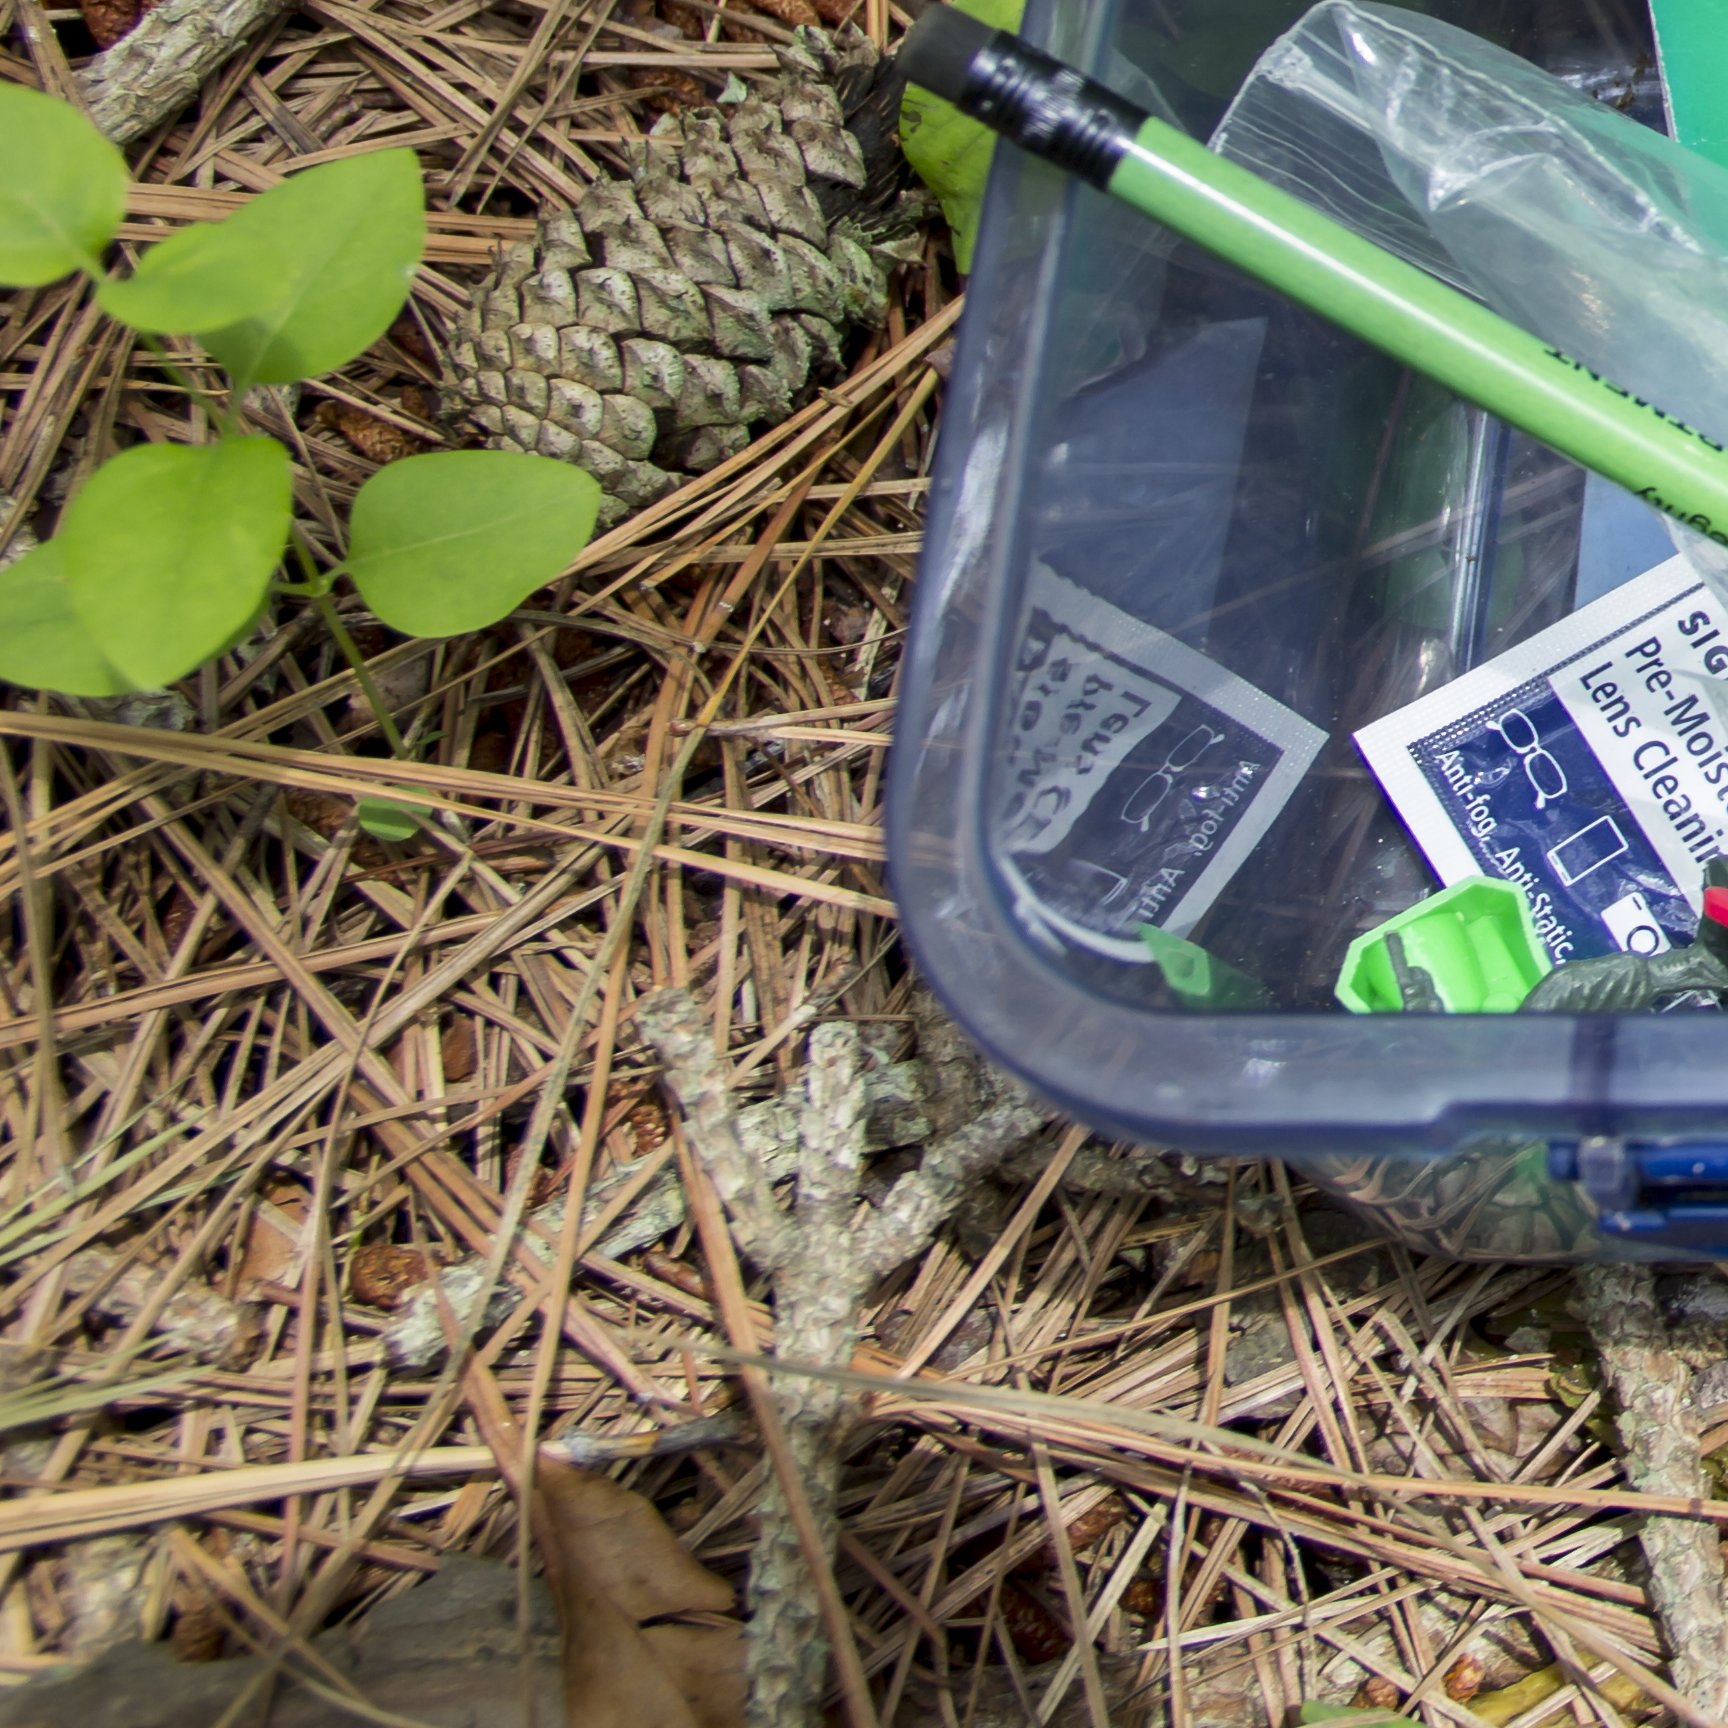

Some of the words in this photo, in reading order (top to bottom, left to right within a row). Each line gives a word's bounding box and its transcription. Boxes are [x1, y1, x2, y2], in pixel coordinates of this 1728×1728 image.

[1435, 749, 1496, 842] Anti-fog,
[1496, 846, 1575, 964] Anti-Static,
[1579, 661, 1641, 739] Lens
[1633, 739, 1727, 863] Cleani
